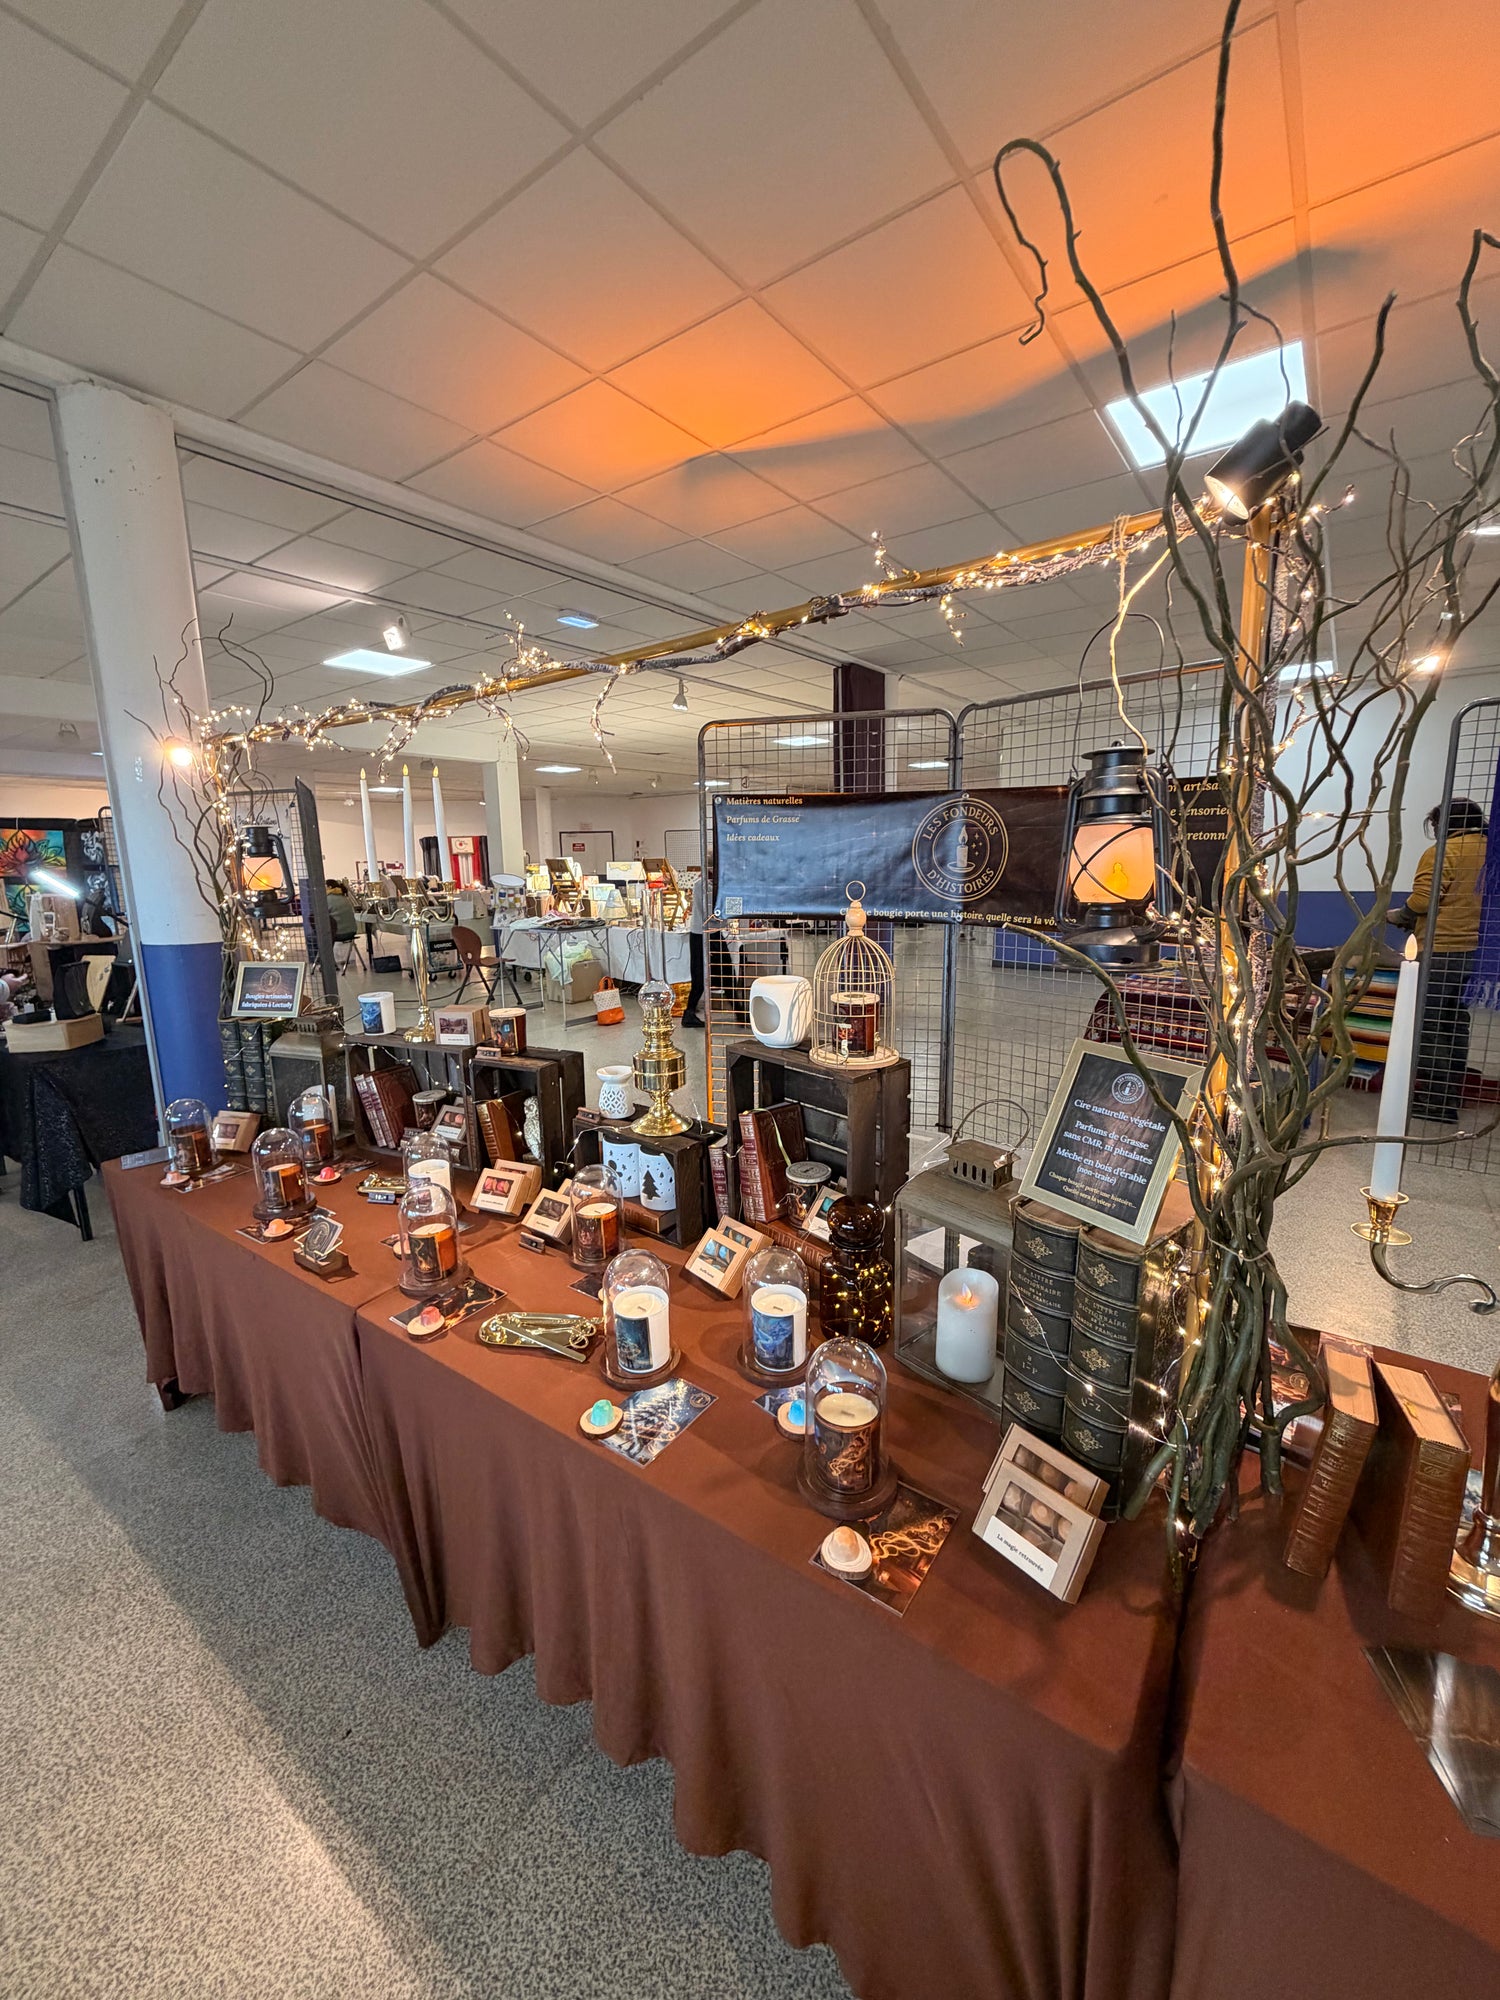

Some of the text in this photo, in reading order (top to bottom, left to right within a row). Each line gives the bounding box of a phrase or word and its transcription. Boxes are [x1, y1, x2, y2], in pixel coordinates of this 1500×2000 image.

[727, 797, 803, 805] Matières naturelles
[726, 815, 759, 825] Parfums
[761, 815, 770, 823] de
[923, 806, 999, 840] LES FONDEURS
[727, 833, 780, 841] Idées cadeaux
[927, 867, 994, 893] D'HISTOIRES
[874, 908, 901, 919] bougie
[905, 910, 929, 919] porte
[986, 913, 1012, 922] quelle
[1014, 916, 1031, 924] sera
[1034, 916, 1042, 925] la
[1074, 1099, 1166, 1132] Cire naturelle végétale
[1075, 1120, 1150, 1150] Parfums de Grasse
[1063, 1131, 1153, 1165] sans CMR, ni phtalates
[1056, 1147, 1147, 1185] Mèche en bois d'érable
[1077, 1166, 1117, 1184] (non-traité)
[1049, 1171, 1068, 1182] Chaque
[1068, 1178, 1084, 1189] bougie
[1063, 1185, 1079, 1195] Quelle
[997, 1534, 1044, 1572] La magie retrouvée
